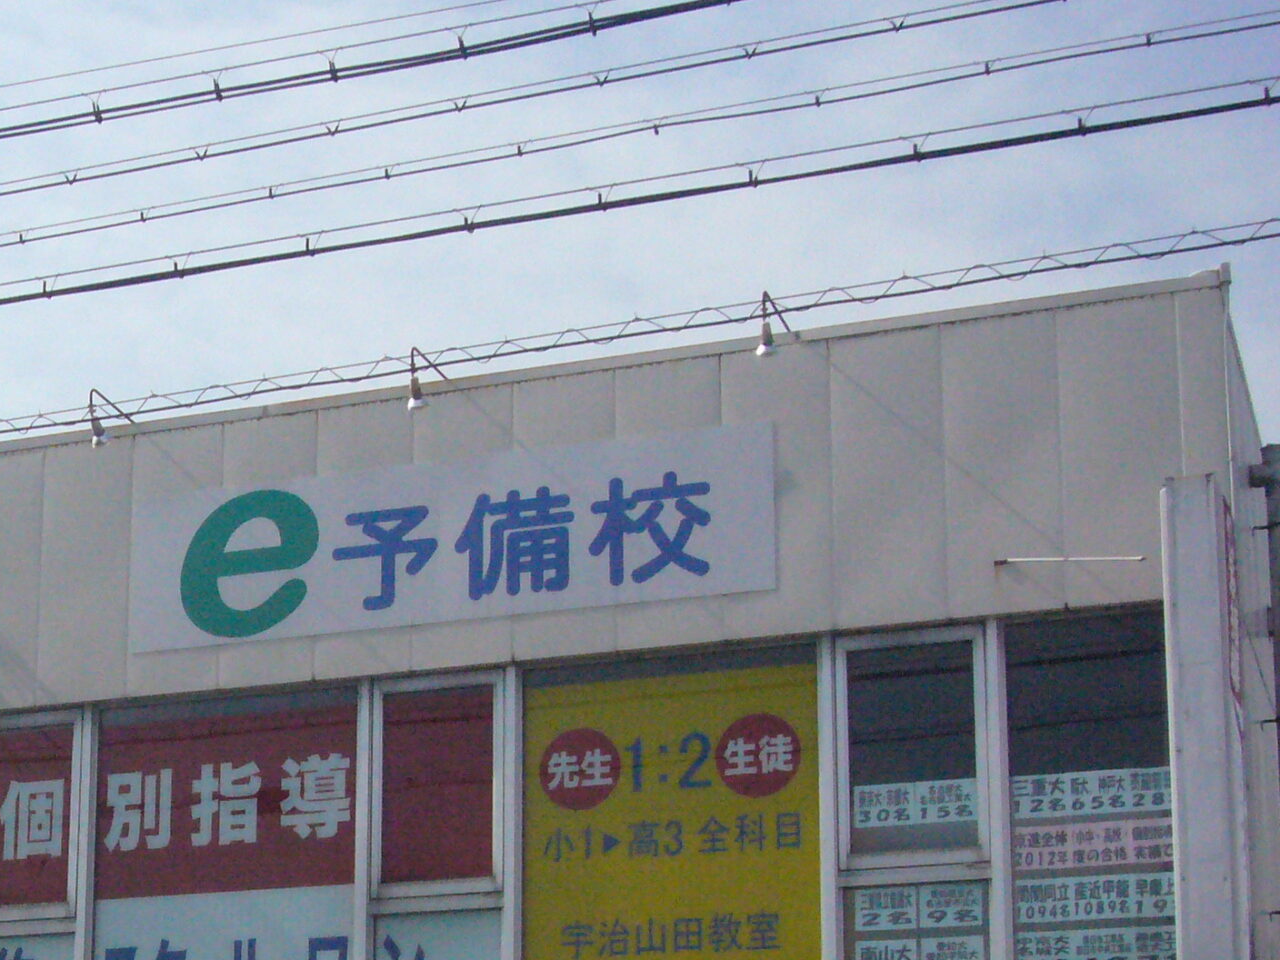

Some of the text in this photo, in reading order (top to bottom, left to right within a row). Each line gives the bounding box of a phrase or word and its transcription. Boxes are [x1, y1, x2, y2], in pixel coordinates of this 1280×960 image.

[546, 747, 614, 790] 先生
[723, 734, 795, 777] 生徒
[1071, 794, 1126, 810] 65名
[1132, 791, 1171, 807] 28
[858, 804, 974, 823] 30名 15名
[697, 812, 803, 856] 全科目
[1135, 898, 1175, 914] 19
[861, 909, 979, 927] 2名 9名
[561, 911, 783, 960] 宇治山田教室
